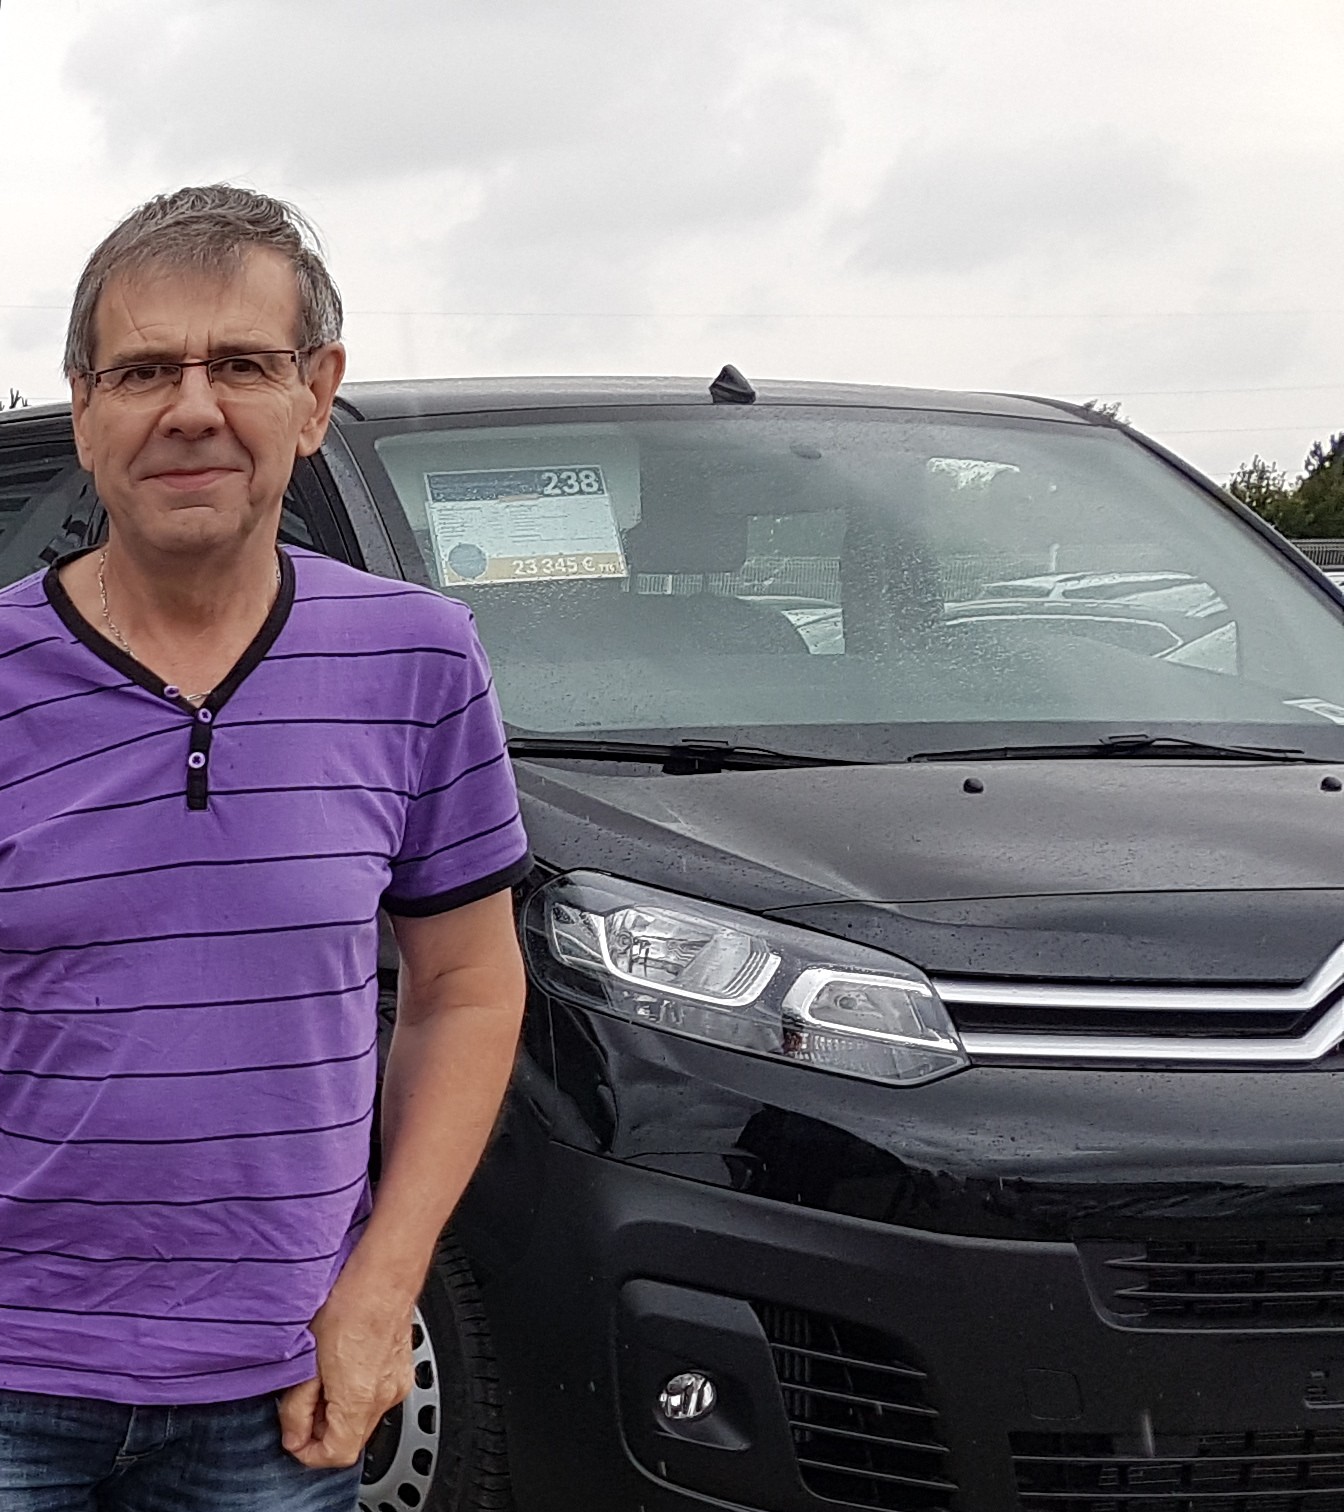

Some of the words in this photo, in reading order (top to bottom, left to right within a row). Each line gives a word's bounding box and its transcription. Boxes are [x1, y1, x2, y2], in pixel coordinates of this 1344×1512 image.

[541, 470, 599, 495] 238
[512, 560, 538, 575] 23
[541, 557, 578, 574] 345
[582, 557, 596, 572] €
